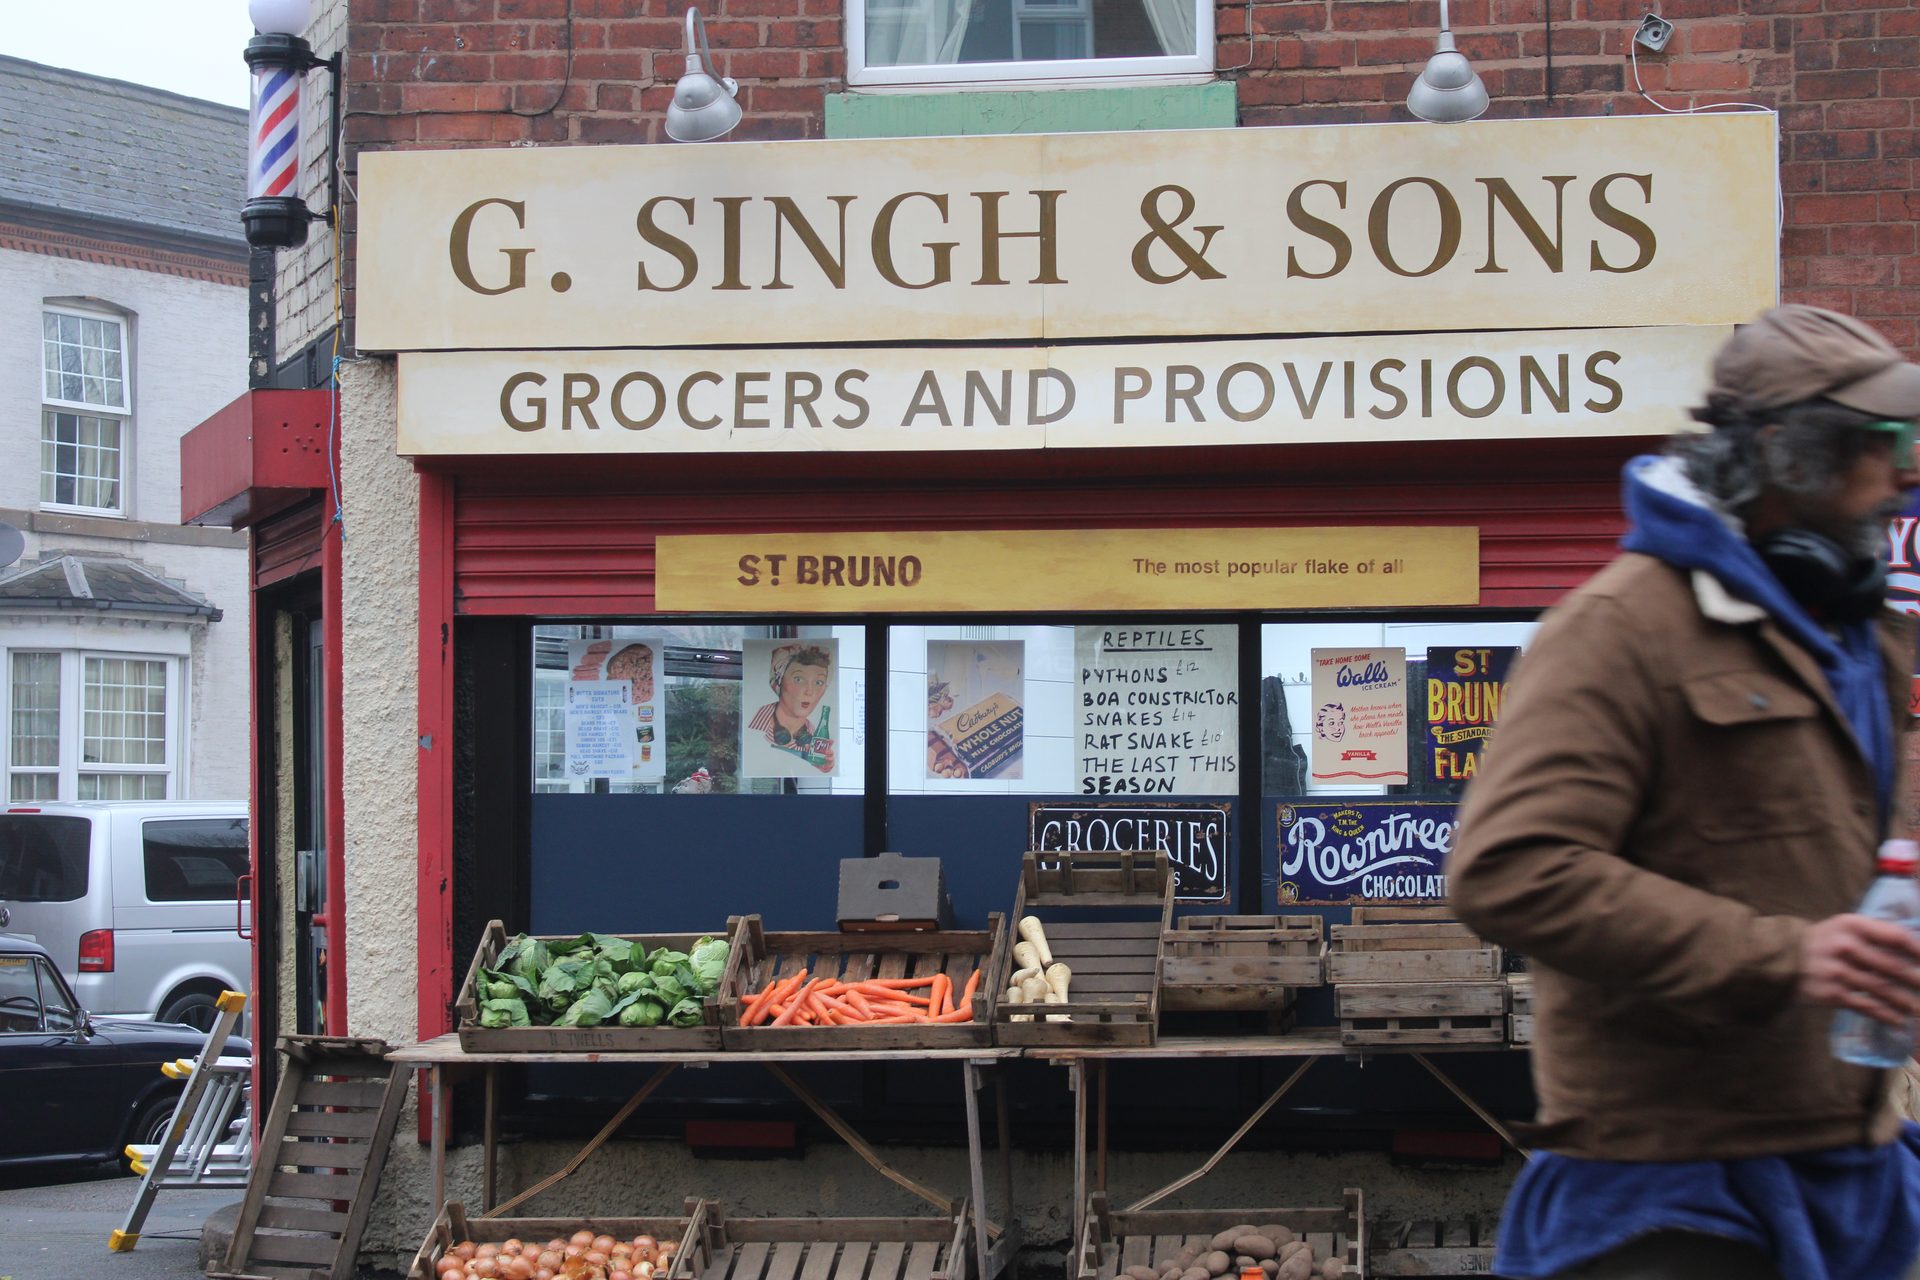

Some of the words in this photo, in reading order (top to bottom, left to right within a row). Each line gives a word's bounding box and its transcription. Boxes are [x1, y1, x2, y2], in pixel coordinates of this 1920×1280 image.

[448, 197, 573, 295] G.
[636, 189, 1068, 292] SINGH
[1131, 184, 1227, 284] &
[1286, 172, 1657, 279] SONS
[500, 368, 870, 432] GROCERS
[899, 366, 1077, 427] AND
[1113, 350, 1624, 423] PROVISIONS
[797, 555, 921, 587] BRUNO
[1133, 558, 1166, 576] The
[1174, 559, 1220, 574] most
[1227, 559, 1298, 578] popular
[1305, 558, 1349, 574] flake
[1356, 558, 1376, 574] of
[1103, 629, 1206, 647] REPTILES
[1335, 656, 1353, 665] HOME
[1354, 653, 1371, 662] SOME
[1082, 667, 1168, 685] PYTHONS
[1176, 660, 1199, 675] £12
[1336, 660, 1389, 688] Wall's
[1083, 692, 1120, 706] BOA
[1128, 689, 1238, 706] CONSTRICTOR
[957, 702, 999, 733] Cadbury's
[1084, 711, 1163, 726] SNAKES
[959, 723, 1001, 752] WHOLE
[999, 709, 1023, 727] NUT
[1440, 732, 1455, 743] THE
[971, 744, 990, 758] MILK
[1083, 757, 1124, 773] THE
[1131, 756, 1179, 773] LAST
[1189, 755, 1236, 772] THIS
[1434, 747, 1486, 779] FLA
[1082, 775, 1176, 794] SEASON
[1333, 810, 1355, 819] MAKERS
[1355, 811, 1362, 819] TO
[1332, 825, 1342, 835] KING
[1348, 825, 1364, 836] QUEEN
[1040, 818, 1218, 881] GROCERIES
[1283, 813, 1460, 886] Rowntree'
[1361, 874, 1450, 898] CHOCOLAT
